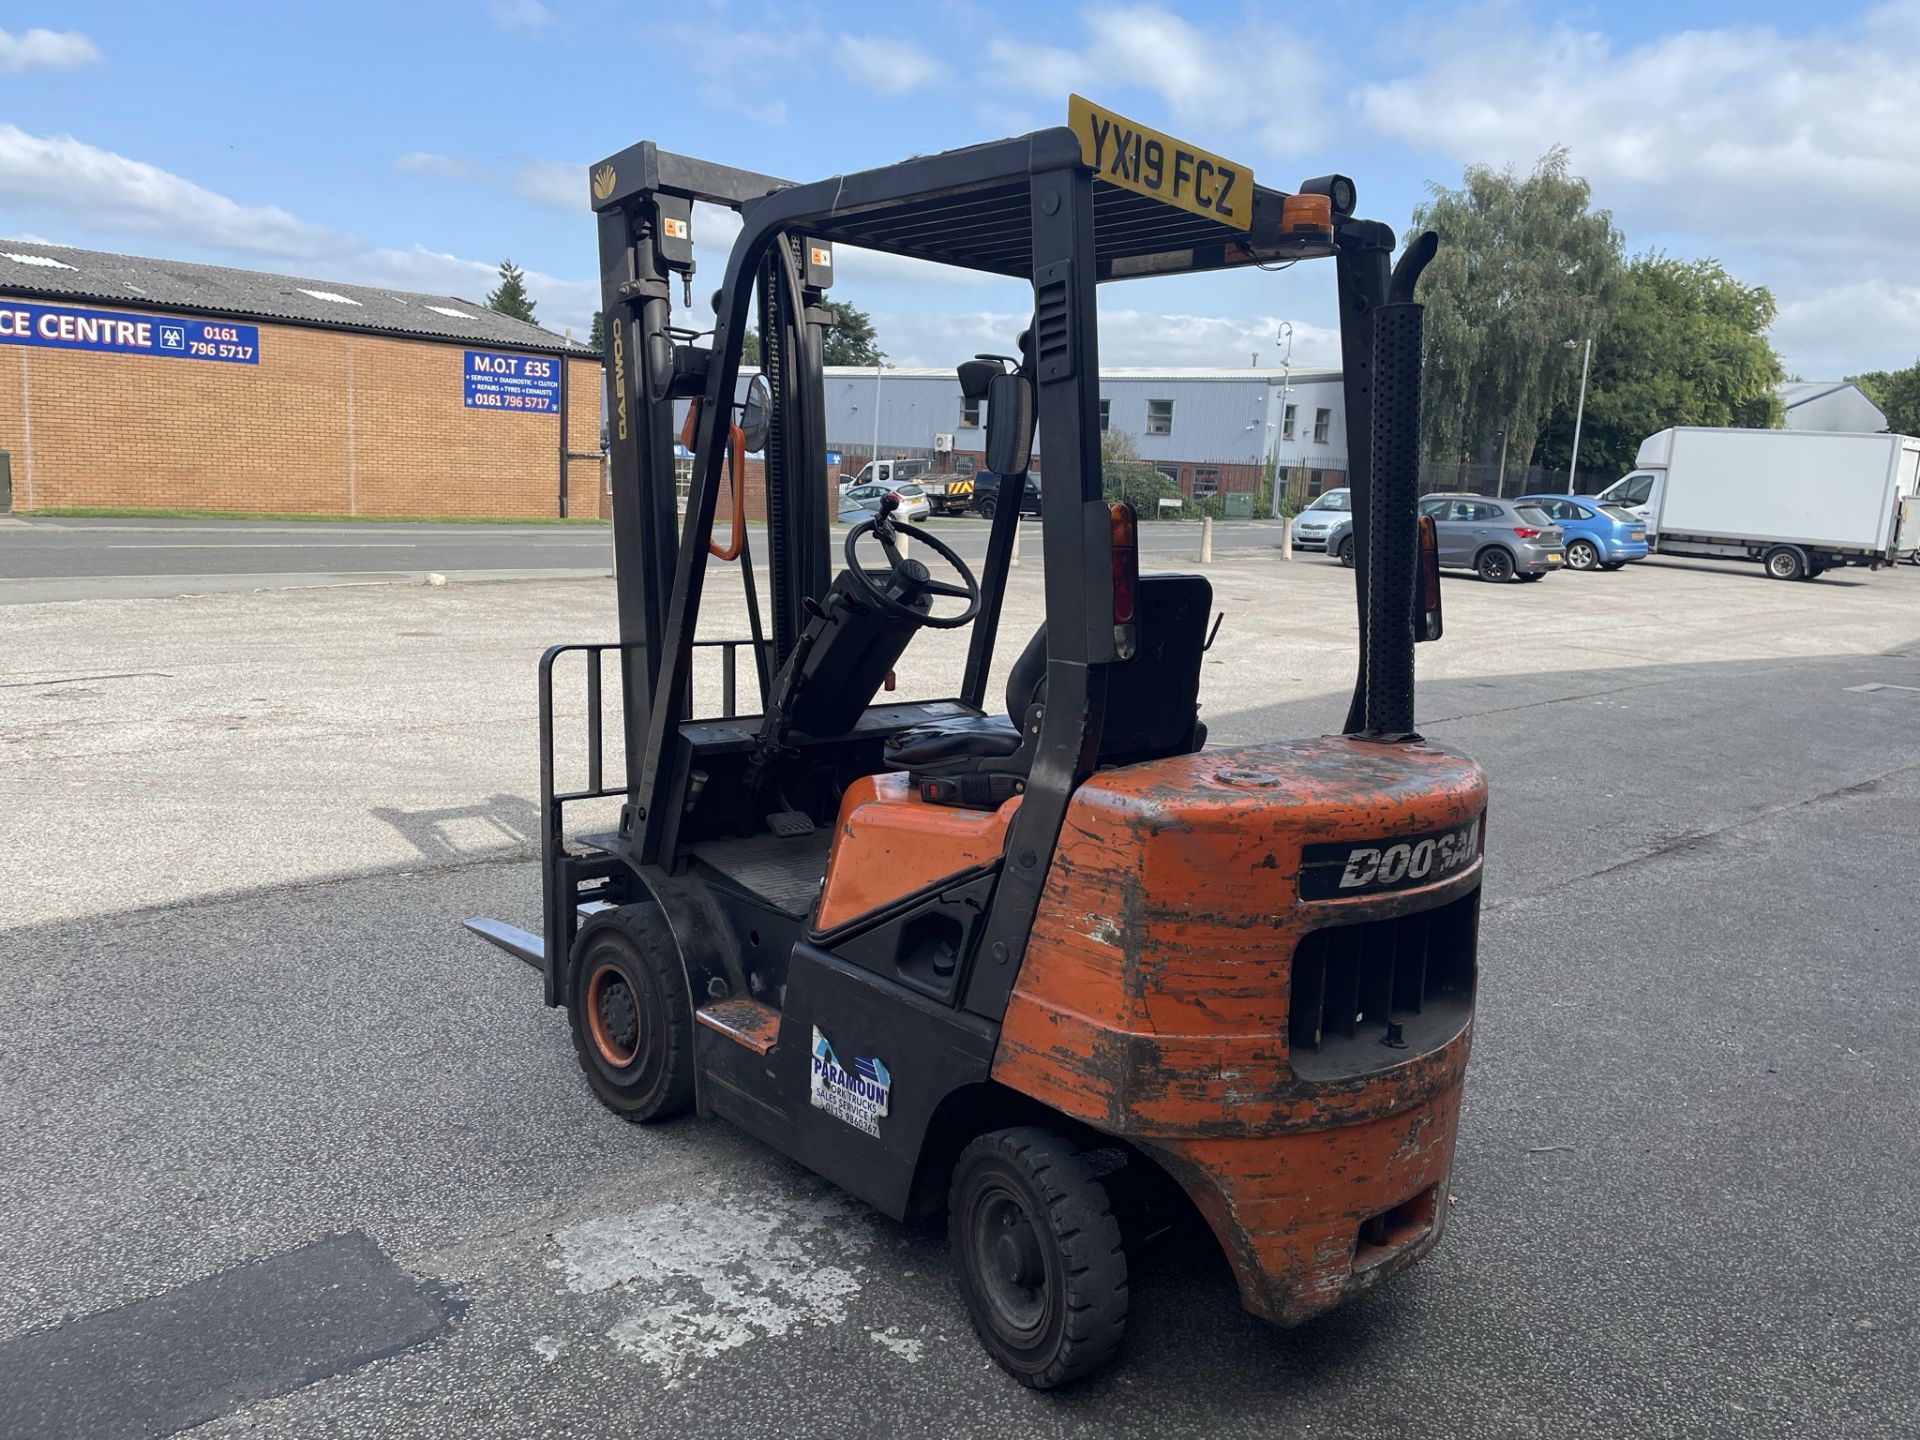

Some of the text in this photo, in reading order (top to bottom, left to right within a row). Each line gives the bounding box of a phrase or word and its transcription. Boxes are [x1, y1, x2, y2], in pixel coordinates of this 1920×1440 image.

[1091, 113, 1236, 217] YX19 FCZ
[38, 313, 152, 346] CENTRE
[203, 326, 239, 342] 0161
[189, 341, 253, 360] 796 5717
[474, 356, 550, 378] M.O.T £35
[471, 374, 493, 382] SERVICE
[499, 377, 532, 386] DIAGNOSTIC
[477, 384, 500, 392] REPAIRS
[525, 388, 552, 396] EXHAUSTS
[613, 318, 627, 440] DAEWOO
[475, 393, 550, 409] 0161 796 5717
[816, 1088, 837, 1105] SALES
[839, 1099, 868, 1121] SERVICE
[831, 1084, 877, 1114] ORK TRUCKS
[845, 1113, 877, 1135] 9860367
